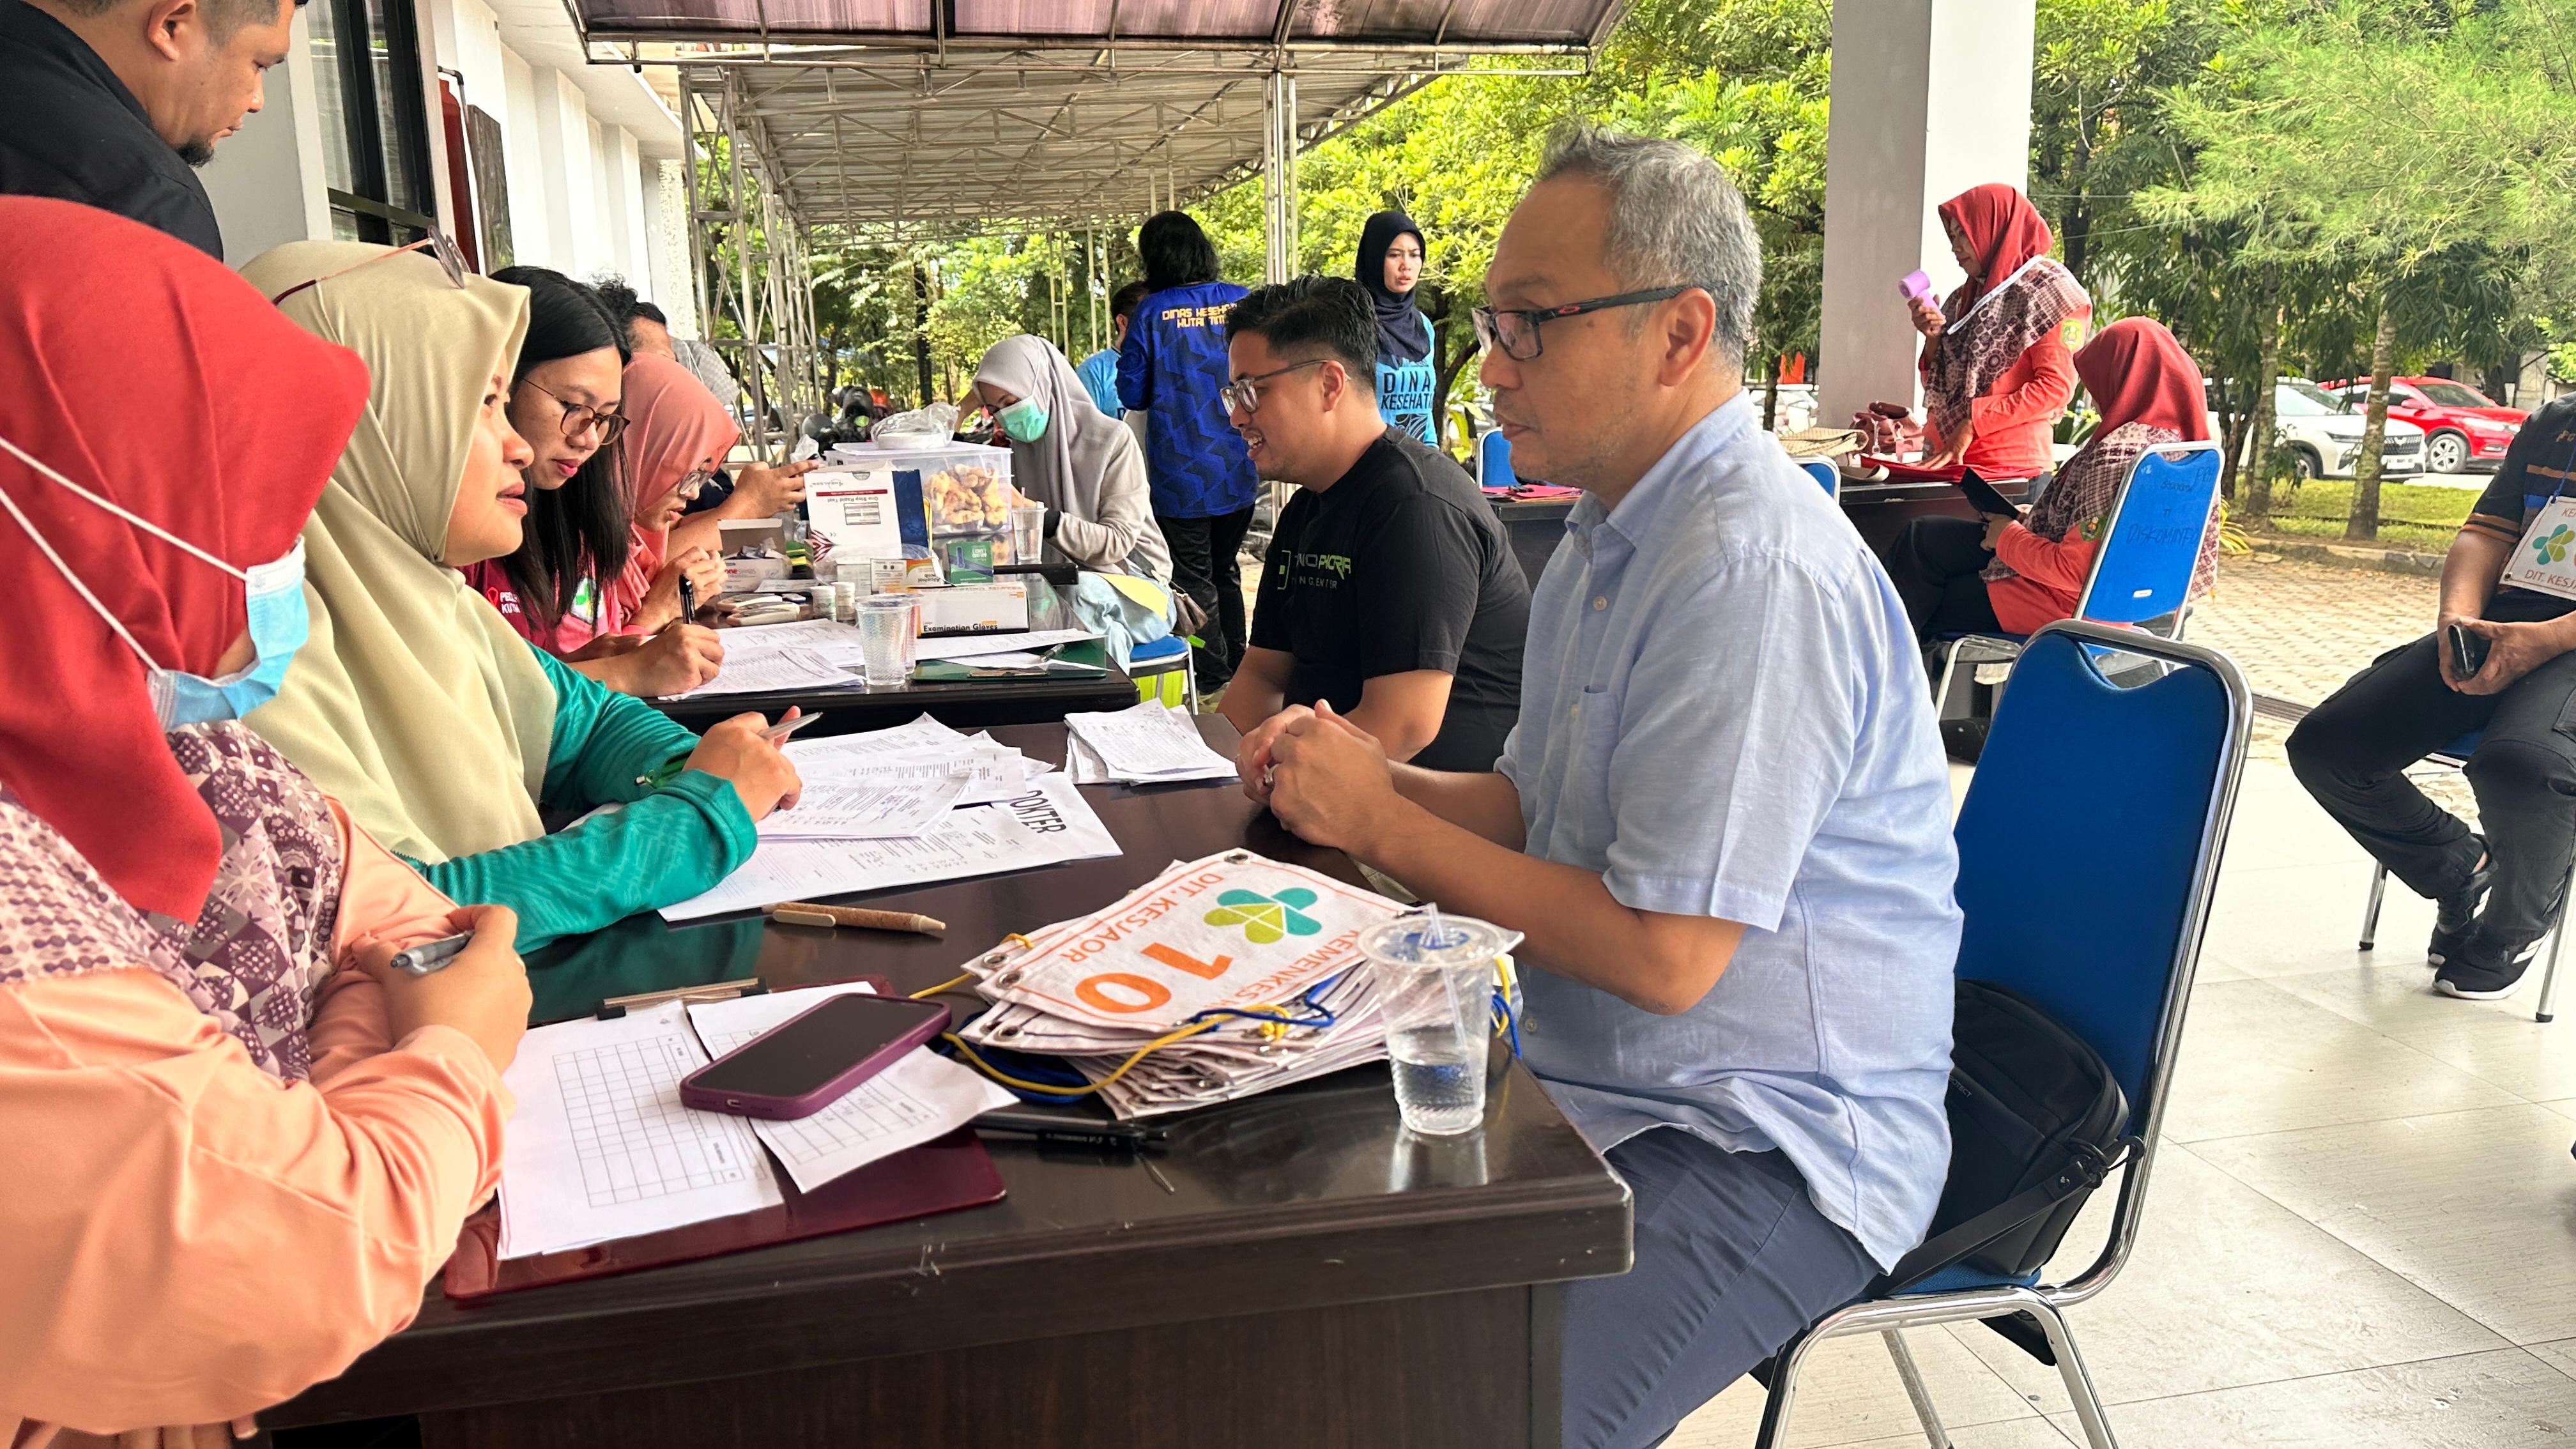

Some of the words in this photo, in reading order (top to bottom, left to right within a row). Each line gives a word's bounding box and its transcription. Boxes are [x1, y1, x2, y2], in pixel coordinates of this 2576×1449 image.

[1162, 308, 1193, 320] DINAS
[1177, 317, 1205, 328] KUTAI
[1209, 314, 1227, 326] TIM
[1383, 371, 1430, 394] DINA
[2128, 524, 2199, 546] DISKOMINFO
[2524, 569, 2545, 582] DIT.
[923, 624, 970, 632] Examination
[972, 623, 998, 631] Gloves
[1010, 790, 1067, 834] DOKTER
[1170, 871, 1225, 896] DIT.
[1059, 896, 1170, 964] KESJAOR
[1236, 930, 1359, 999] KEMENKES
[1075, 942, 1232, 1014] 10
[1949, 1076, 1973, 1098] OTECT
